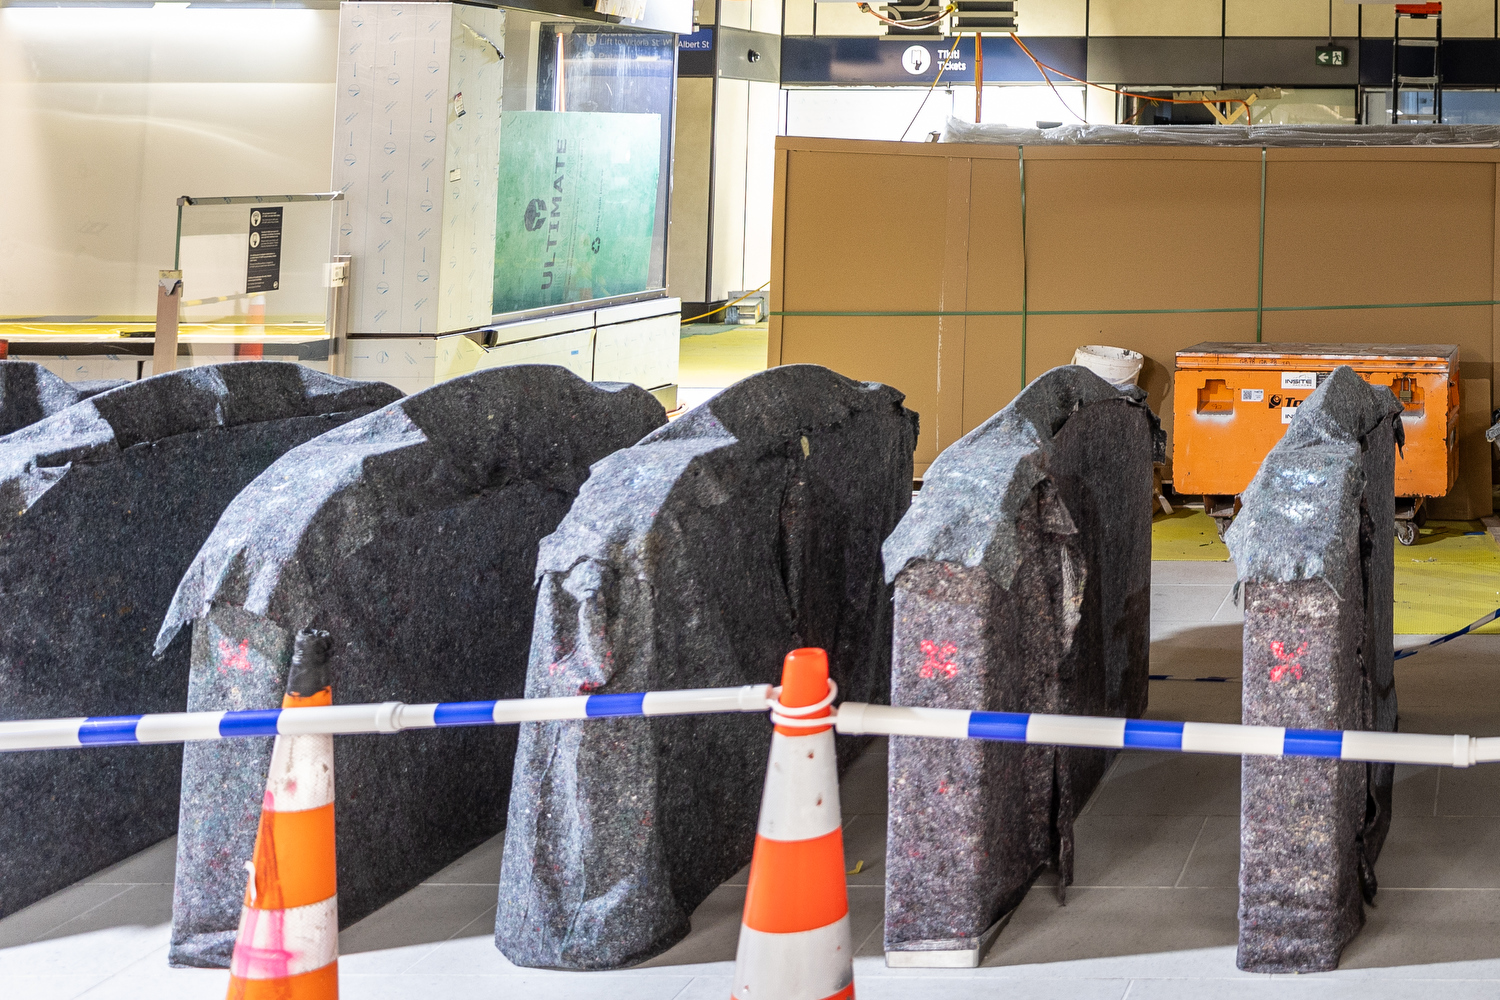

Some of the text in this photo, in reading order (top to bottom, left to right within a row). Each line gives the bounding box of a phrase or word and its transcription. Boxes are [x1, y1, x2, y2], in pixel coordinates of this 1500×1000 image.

[678, 40, 710, 48] Albert St
[541, 138, 567, 290] ULTIMATE
